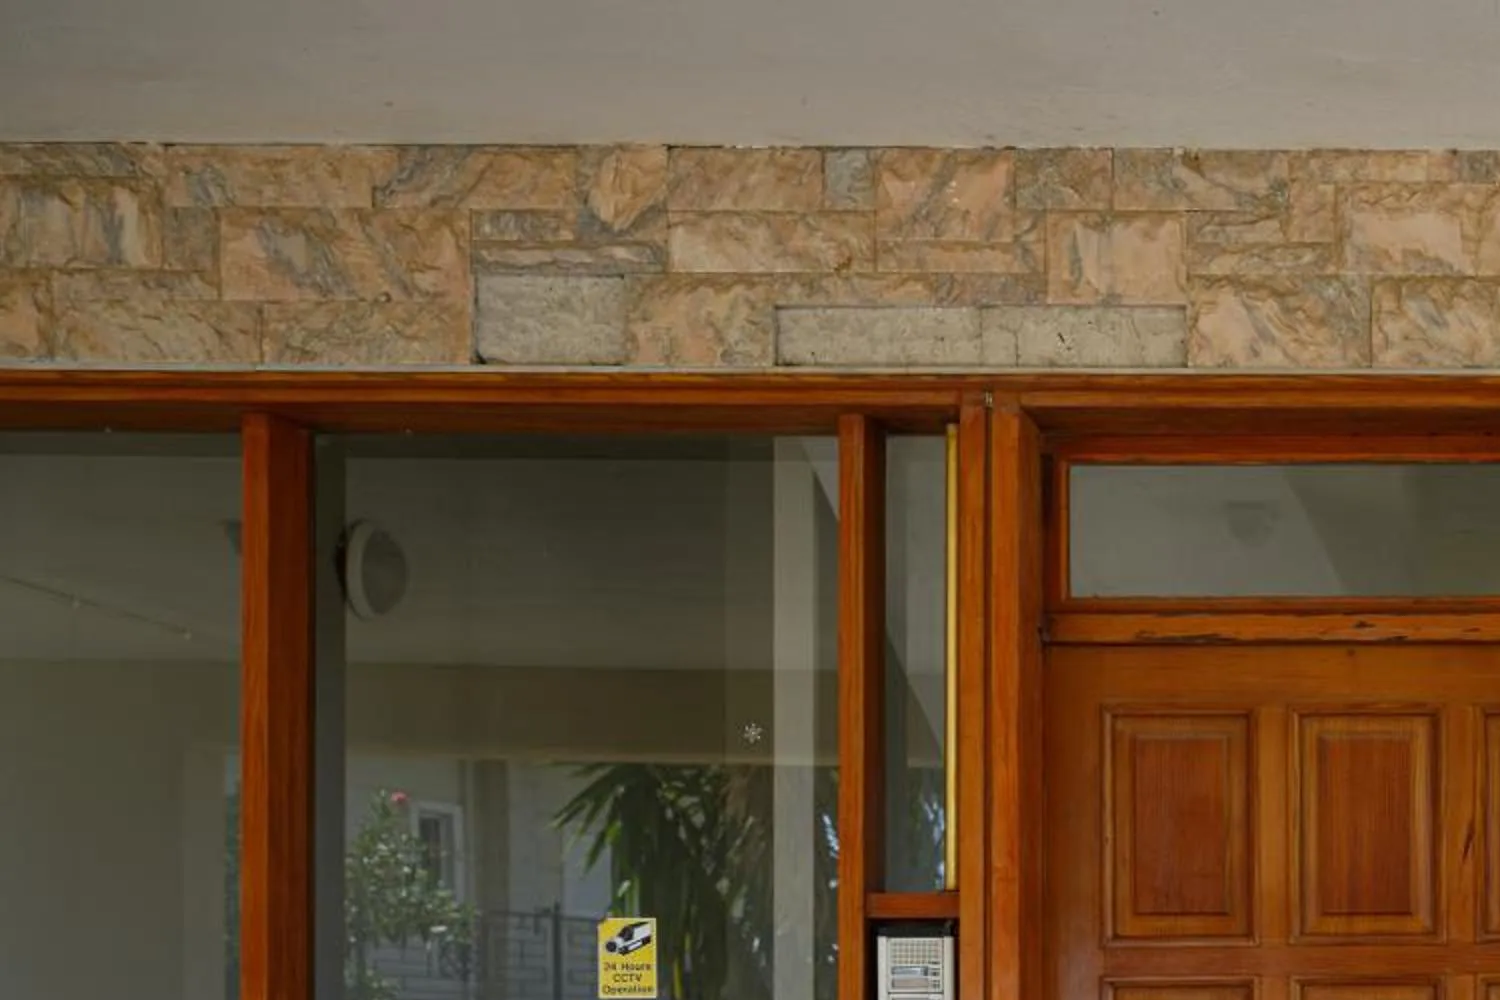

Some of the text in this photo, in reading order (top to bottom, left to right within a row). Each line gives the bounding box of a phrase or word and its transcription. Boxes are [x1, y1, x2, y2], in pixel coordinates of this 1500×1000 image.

[621, 963, 651, 971] Hours
[613, 973, 642, 982] CCTV
[603, 985, 653, 994] Operation
